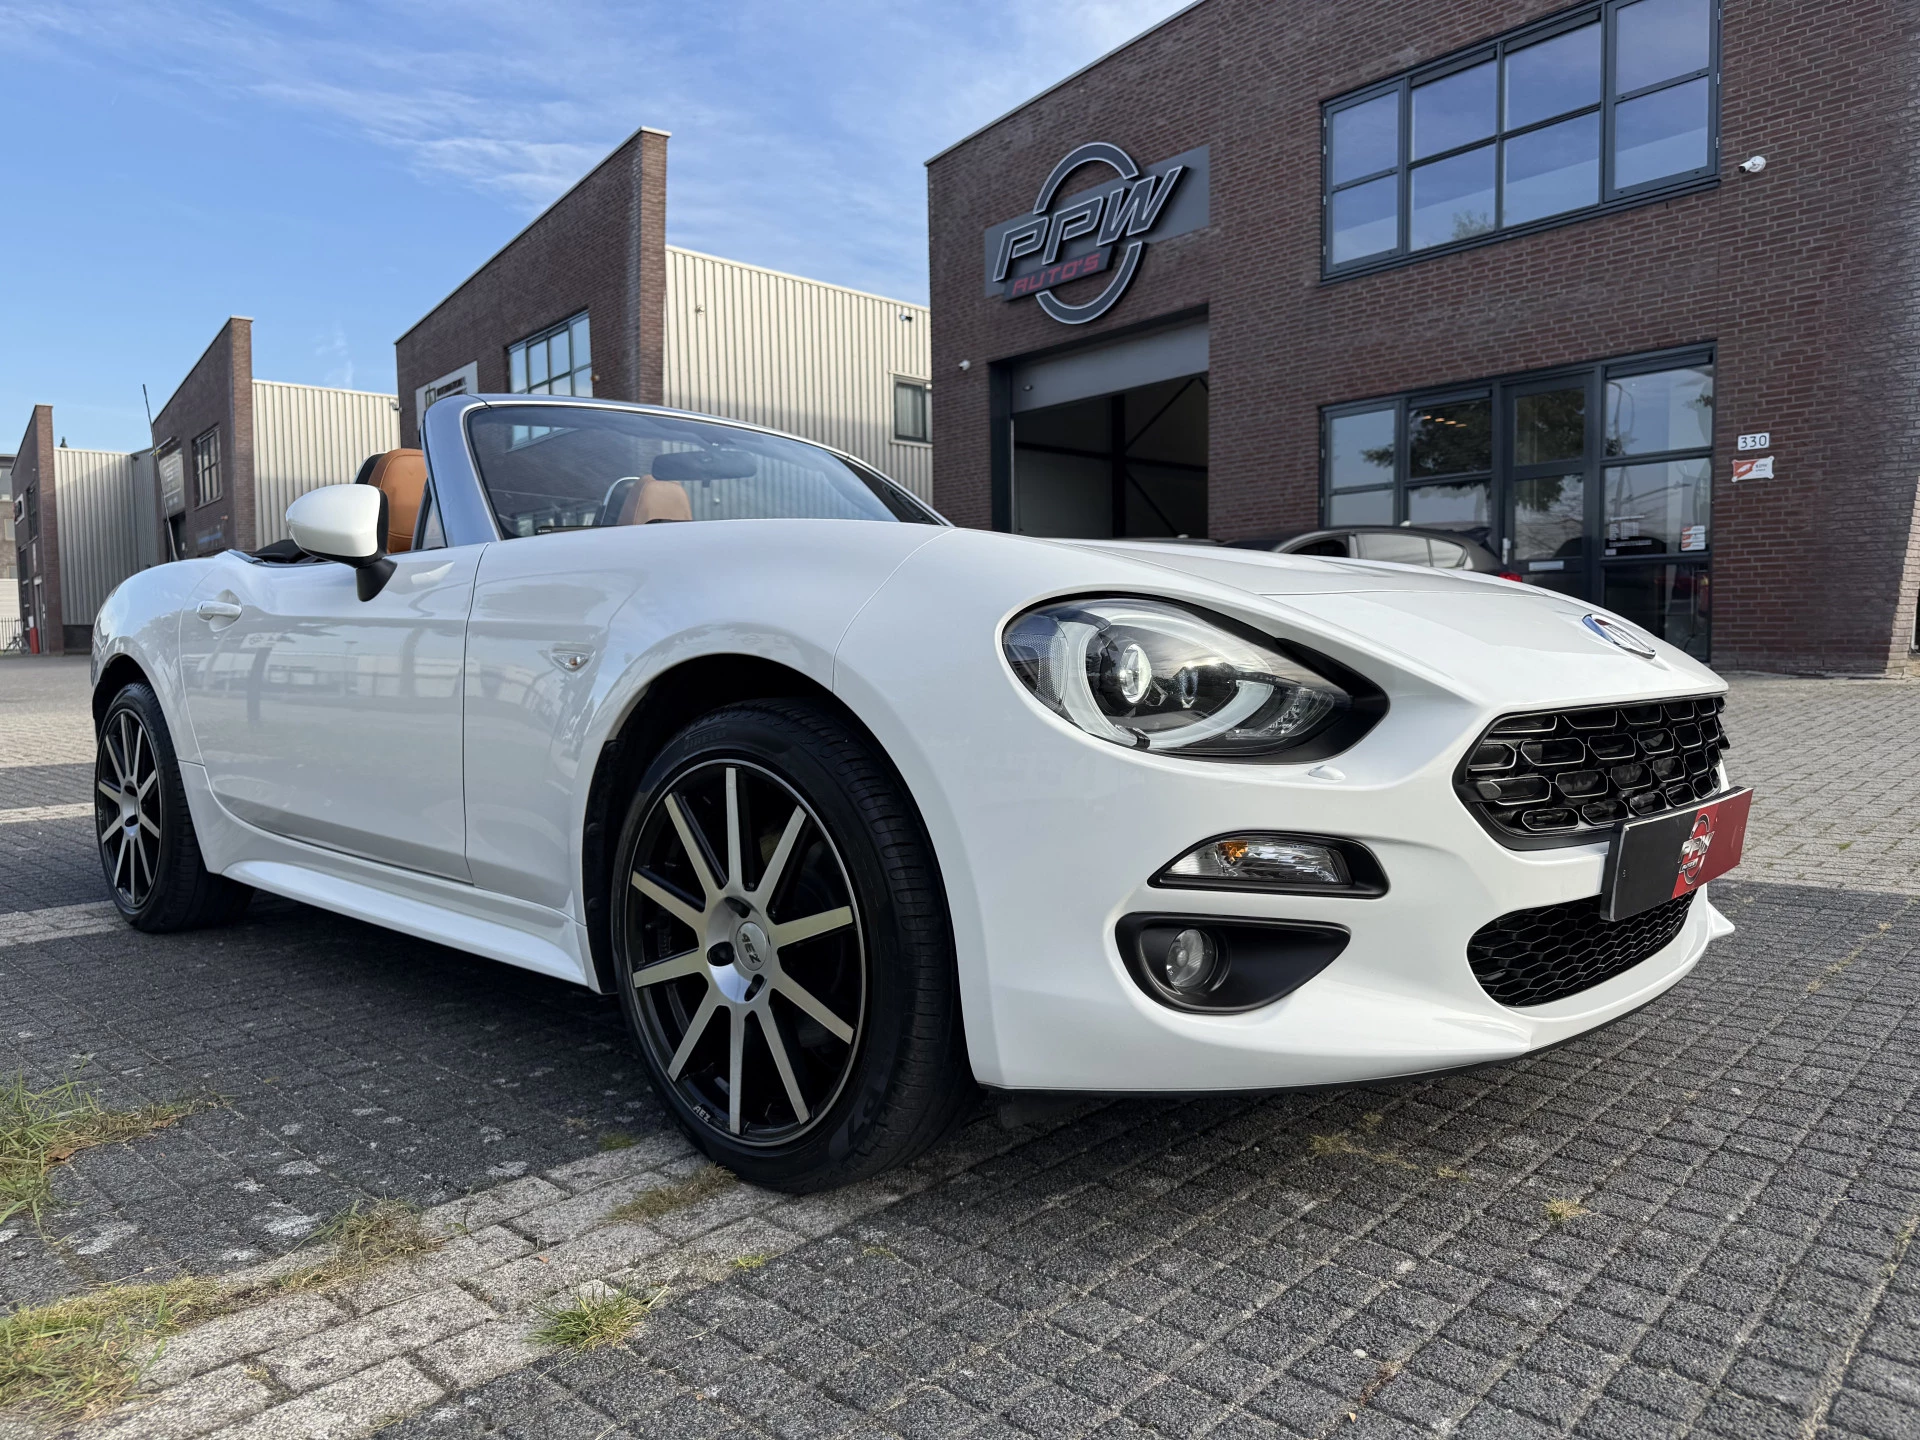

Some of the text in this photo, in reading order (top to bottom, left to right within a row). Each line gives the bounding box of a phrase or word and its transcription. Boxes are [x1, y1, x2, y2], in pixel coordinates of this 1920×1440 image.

[993, 165, 1184, 282] PPW
[1012, 253, 1101, 296] AUTO'S
[1740, 434, 1768, 449] 330
[1677, 831, 1716, 863] PPW
[742, 933, 761, 964] AEZ
[692, 1105, 711, 1123] AEZ
